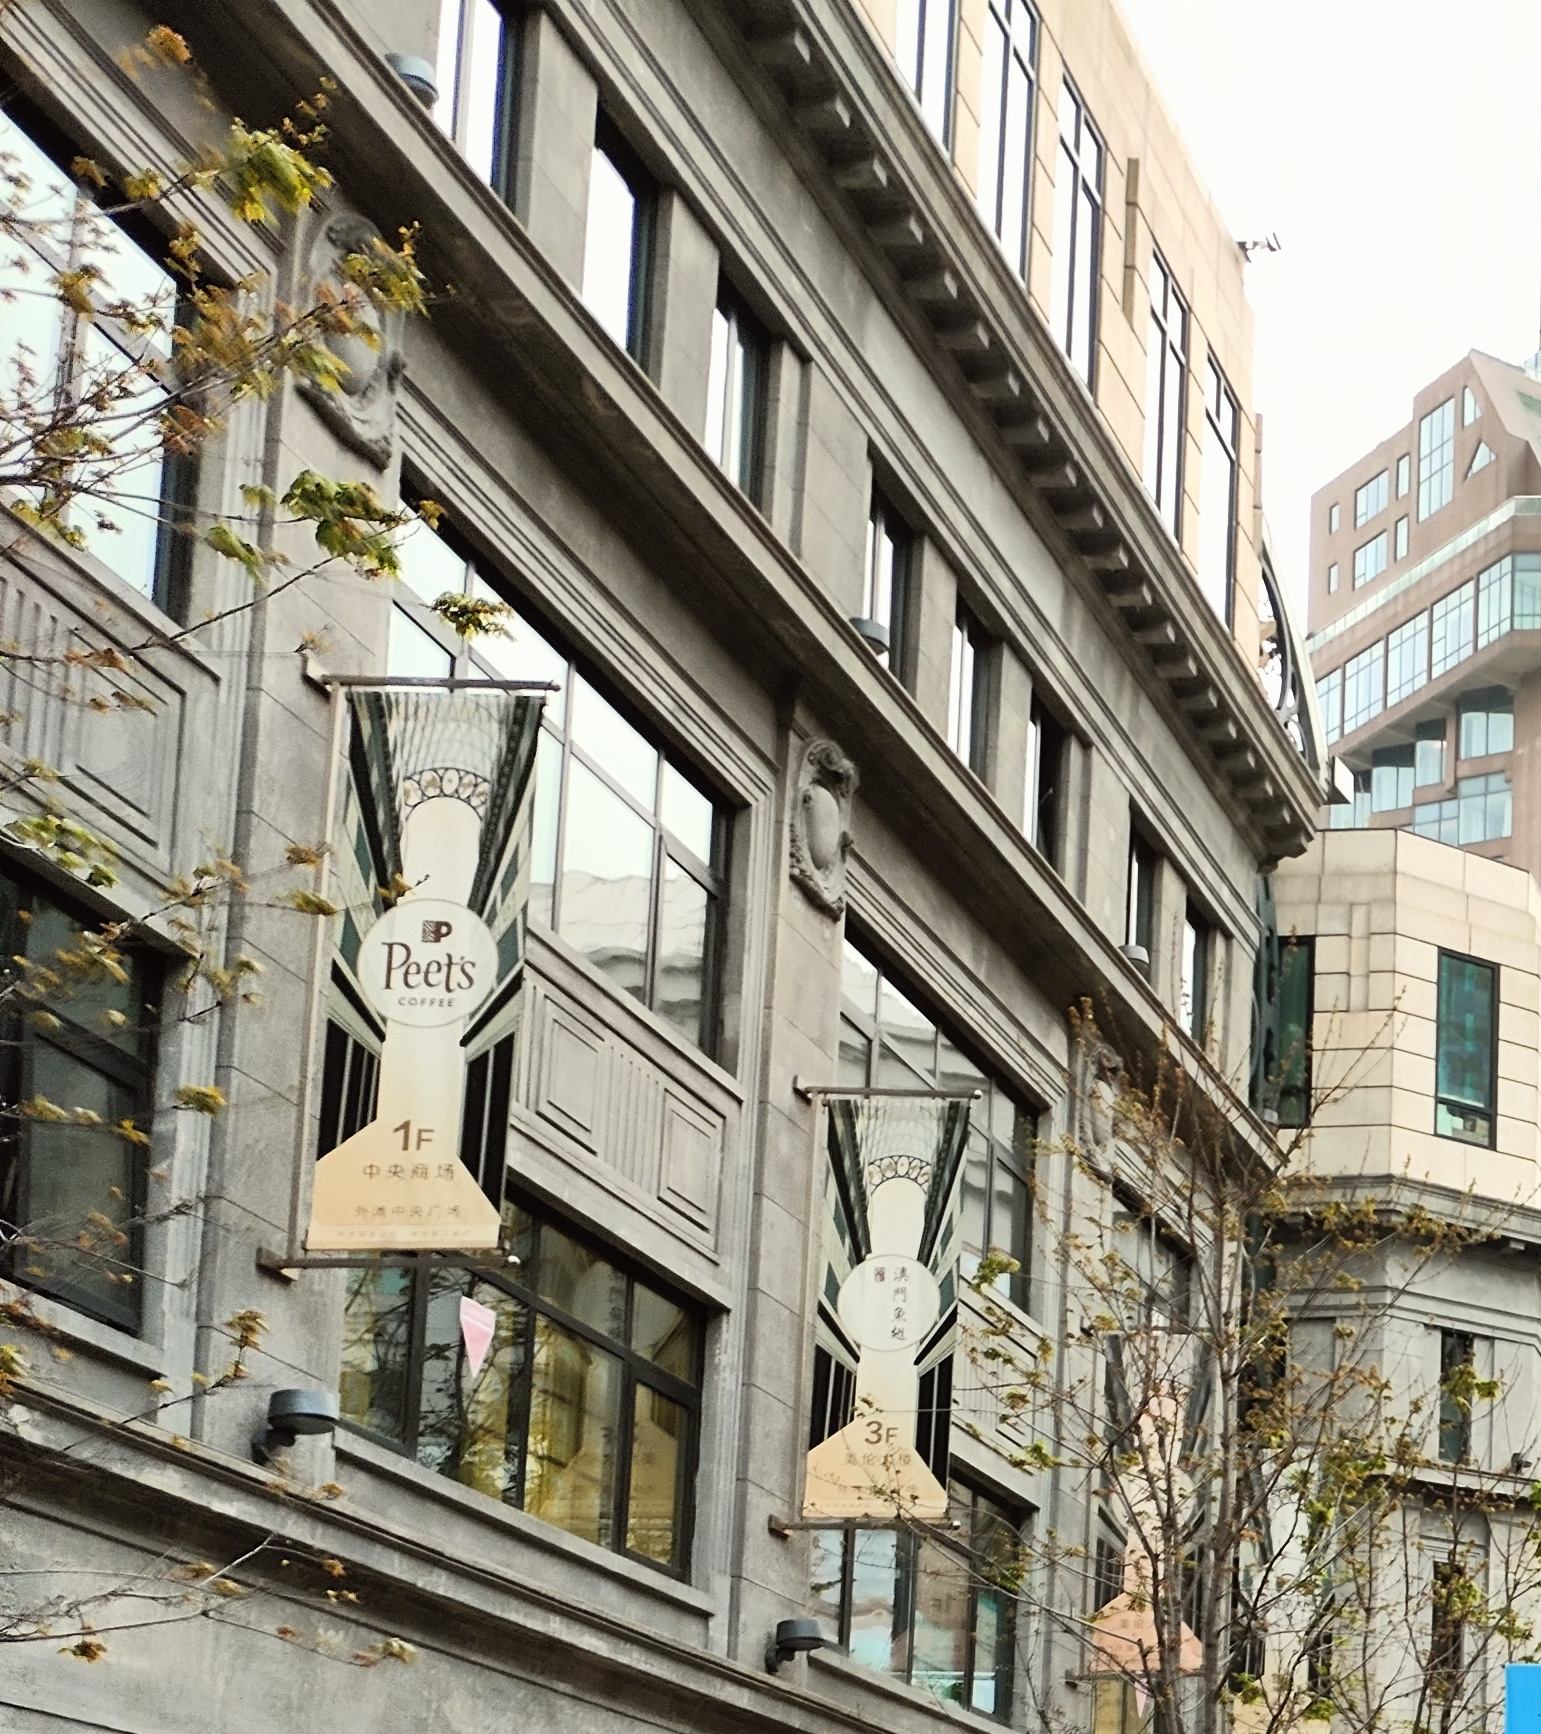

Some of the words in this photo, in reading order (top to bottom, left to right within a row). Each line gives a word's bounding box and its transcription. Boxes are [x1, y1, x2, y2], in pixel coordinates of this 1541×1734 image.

[381, 942, 478, 994] Peet's
[397, 996, 455, 1008] COFFEE
[393, 1120, 435, 1152] 1F
[361, 1163, 455, 1182] 中央商场
[865, 1420, 899, 1445] 3F
